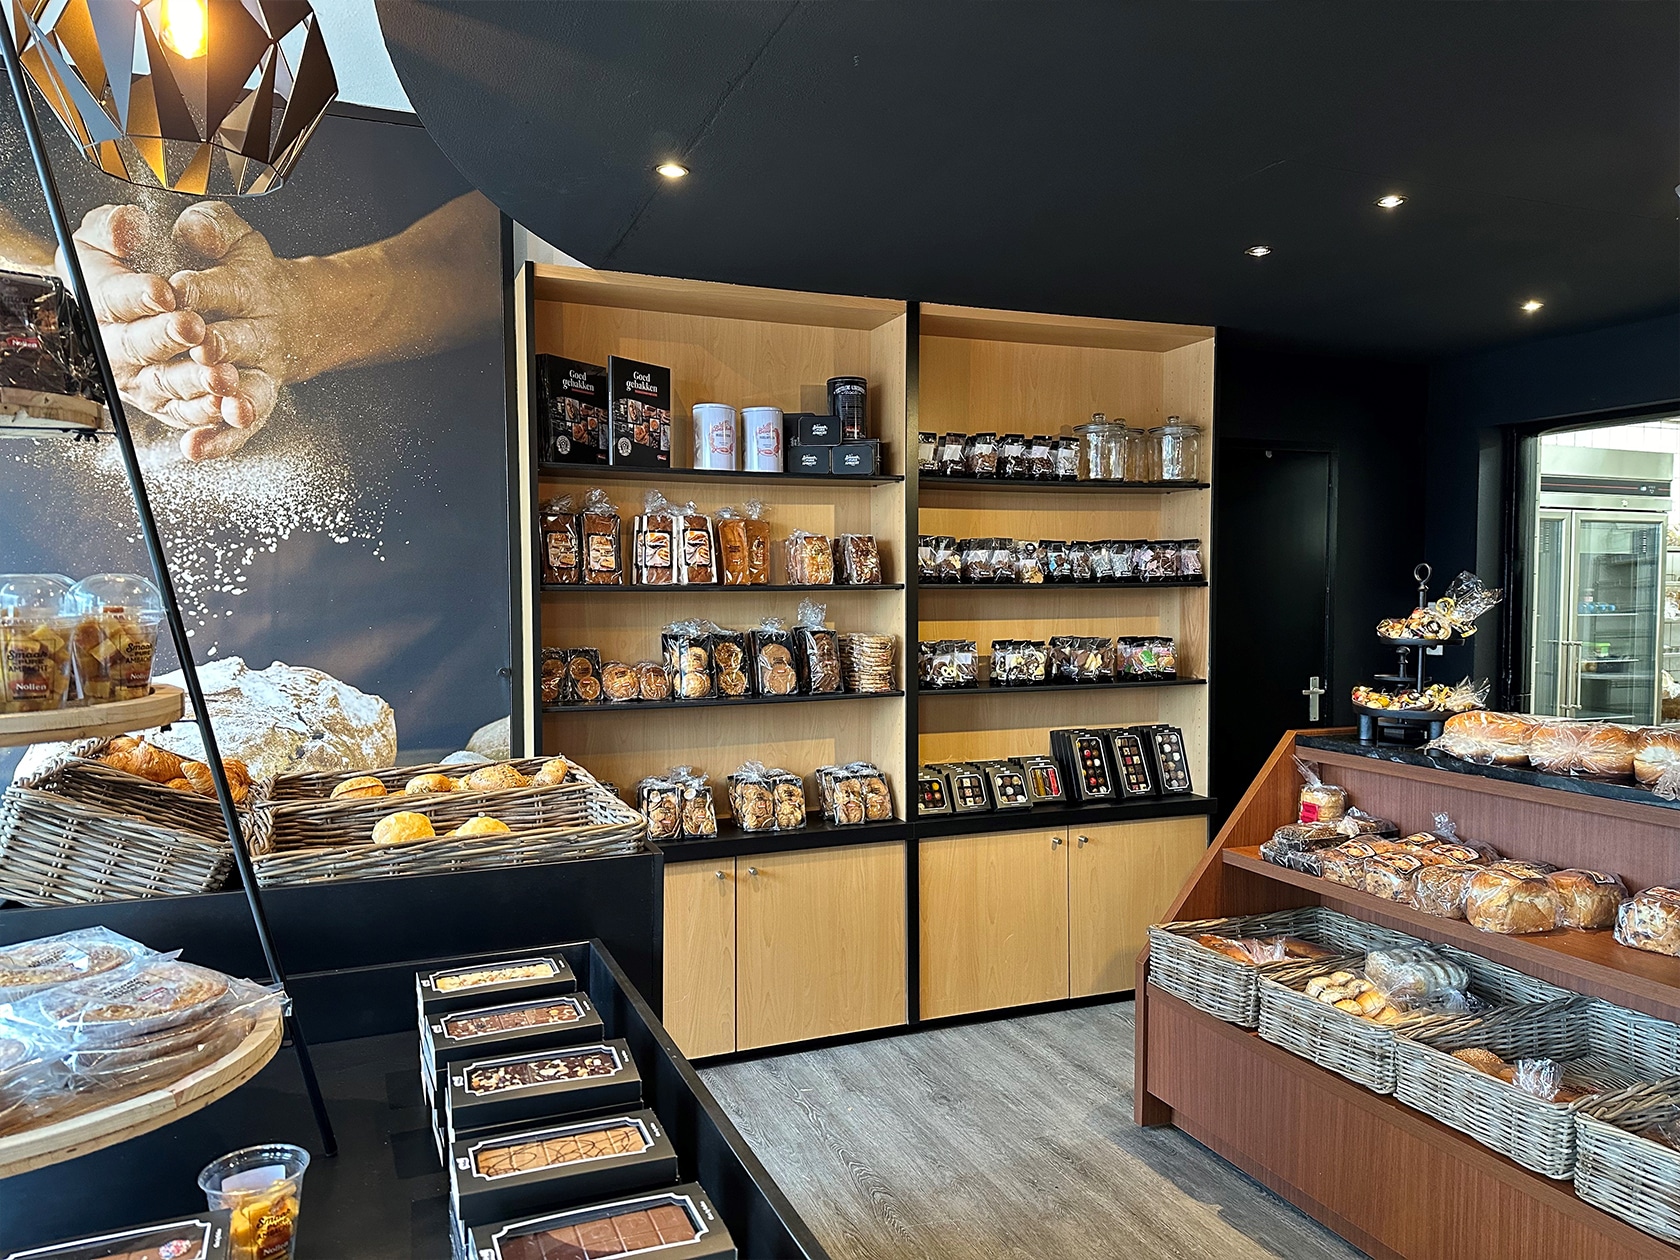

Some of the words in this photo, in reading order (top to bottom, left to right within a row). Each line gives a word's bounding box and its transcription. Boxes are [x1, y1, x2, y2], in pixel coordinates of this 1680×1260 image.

[569, 369, 587, 381] Goed
[633, 371, 651, 382] Goed
[562, 378, 595, 392] gebakken
[626, 379, 658, 393] gebakken
[7, 649, 49, 661] Smaak
[15, 682, 47, 691] Nollen
